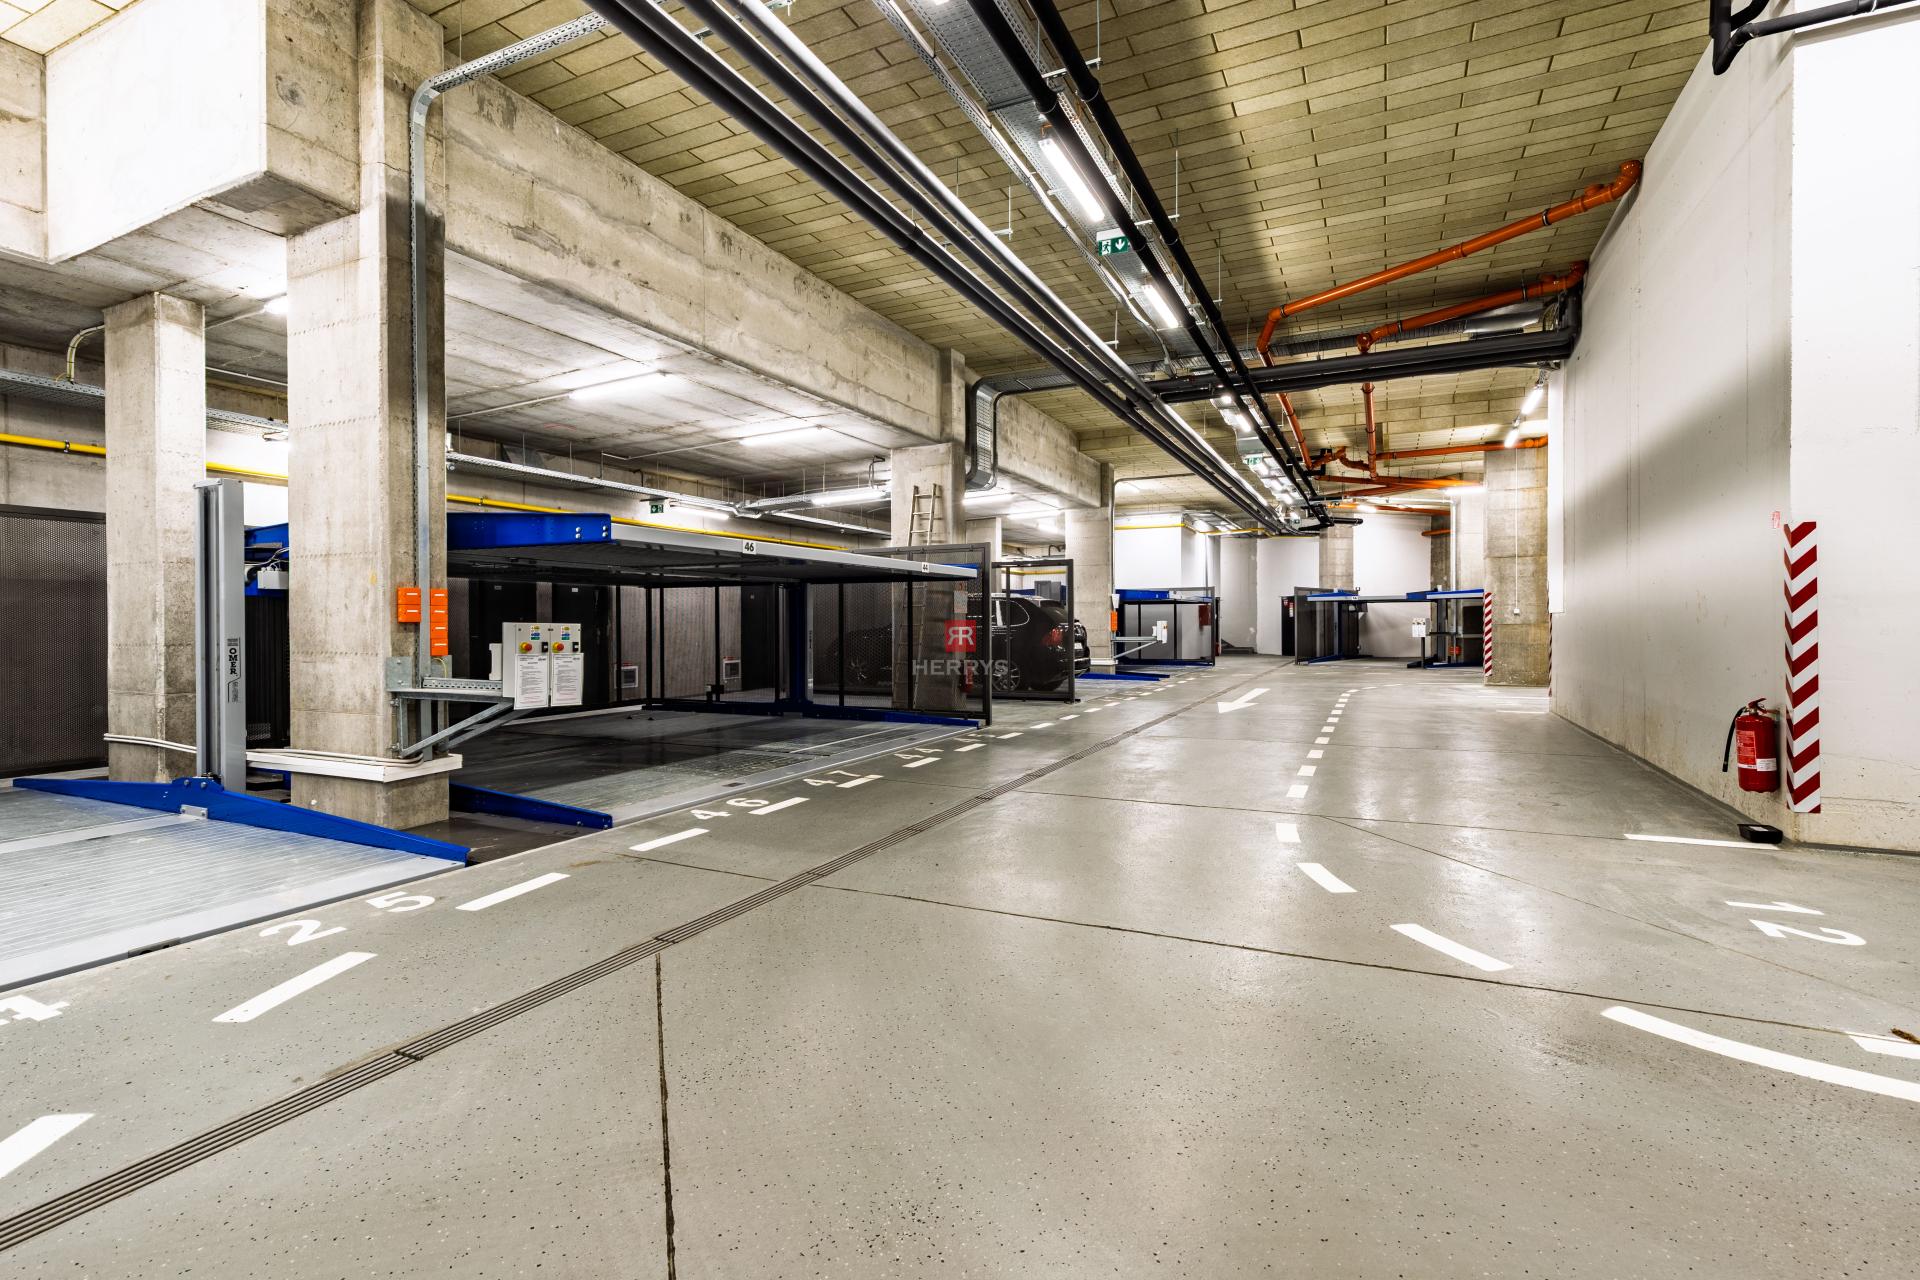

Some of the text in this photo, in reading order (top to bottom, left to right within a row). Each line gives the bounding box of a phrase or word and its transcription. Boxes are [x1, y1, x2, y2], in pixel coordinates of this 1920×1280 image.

[744, 542, 754, 552] 46
[228, 647, 238, 675] OMER
[803, 769, 862, 787] 47
[690, 797, 769, 820] 46
[259, 891, 436, 946] 25
[1724, 900, 1867, 946] 12
